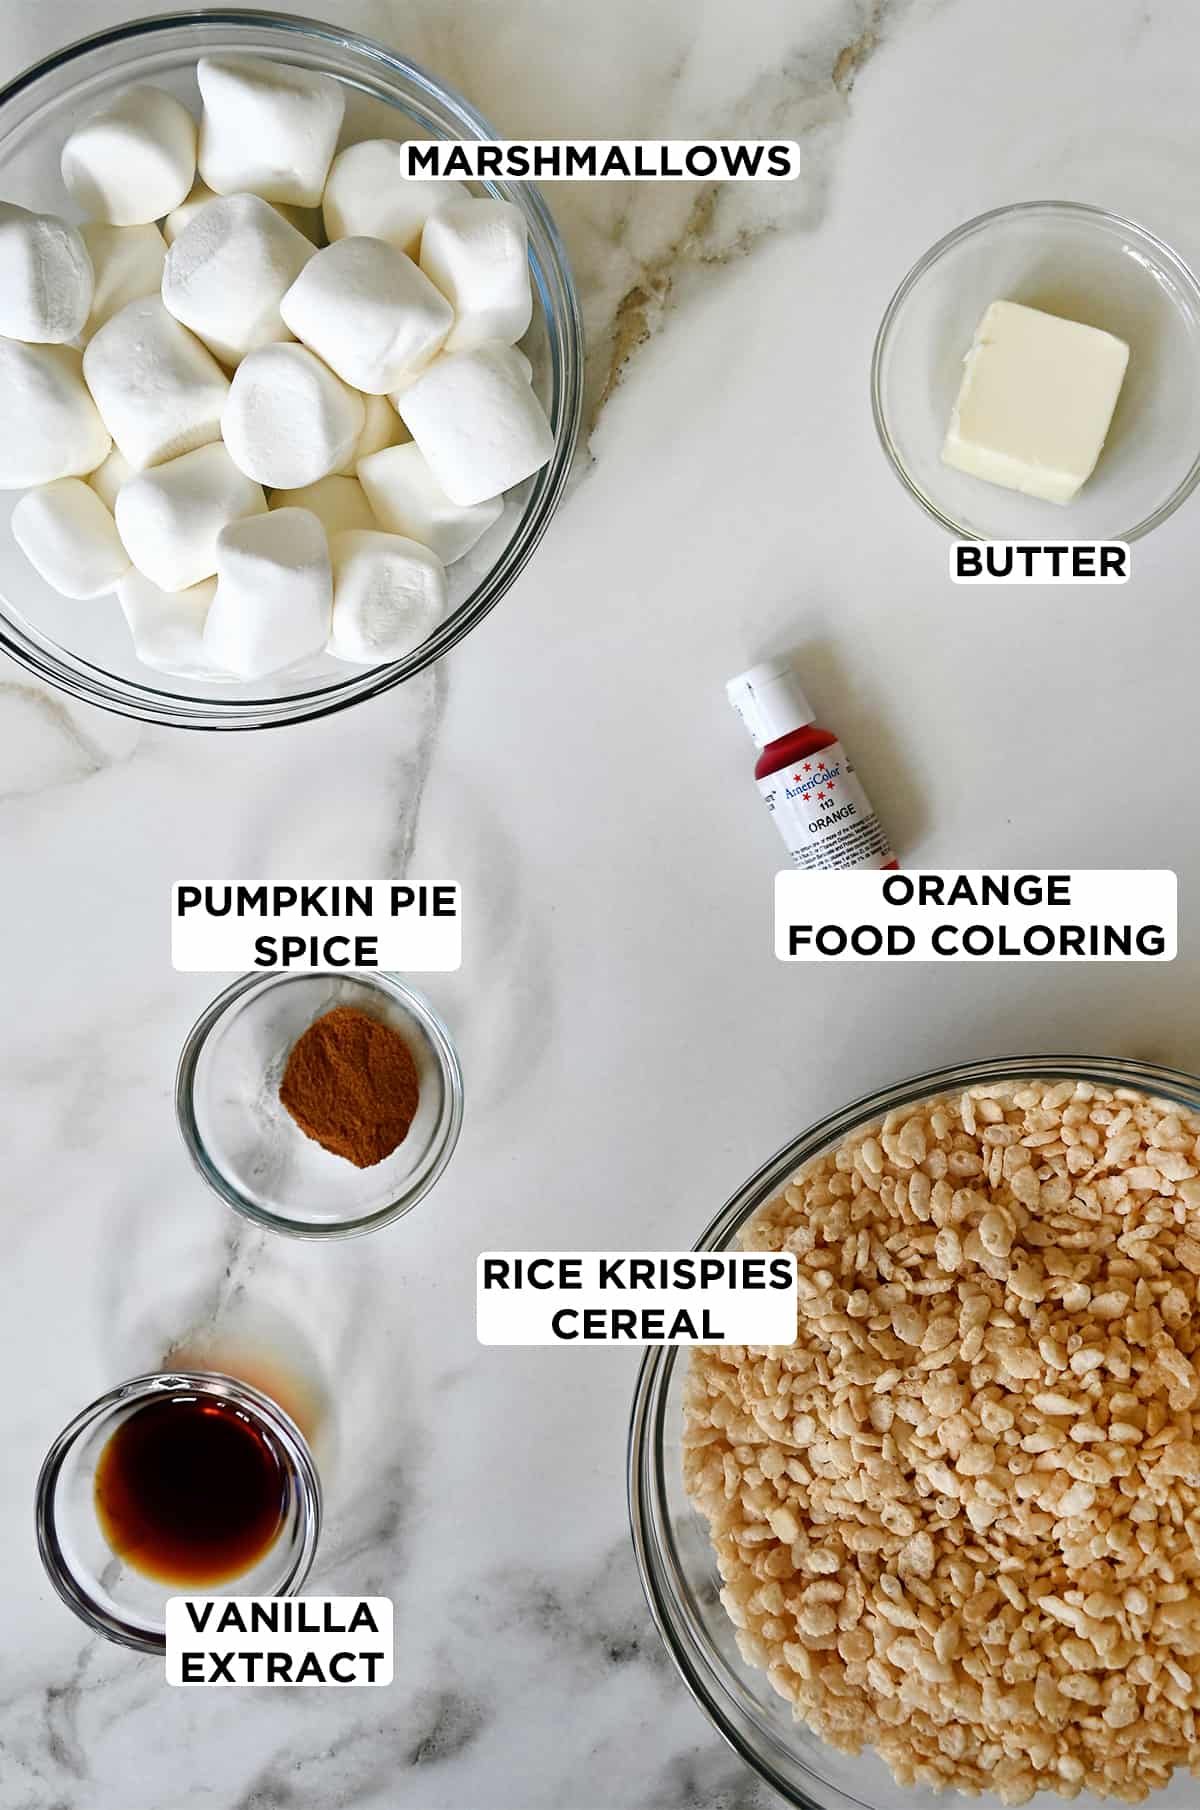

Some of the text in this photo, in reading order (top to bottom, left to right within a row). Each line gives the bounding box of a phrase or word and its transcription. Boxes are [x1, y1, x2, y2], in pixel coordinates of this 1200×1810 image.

[785, 766, 840, 799] AmeriColor
[808, 803, 857, 833] ORANGE
[820, 798, 835, 811] 113
